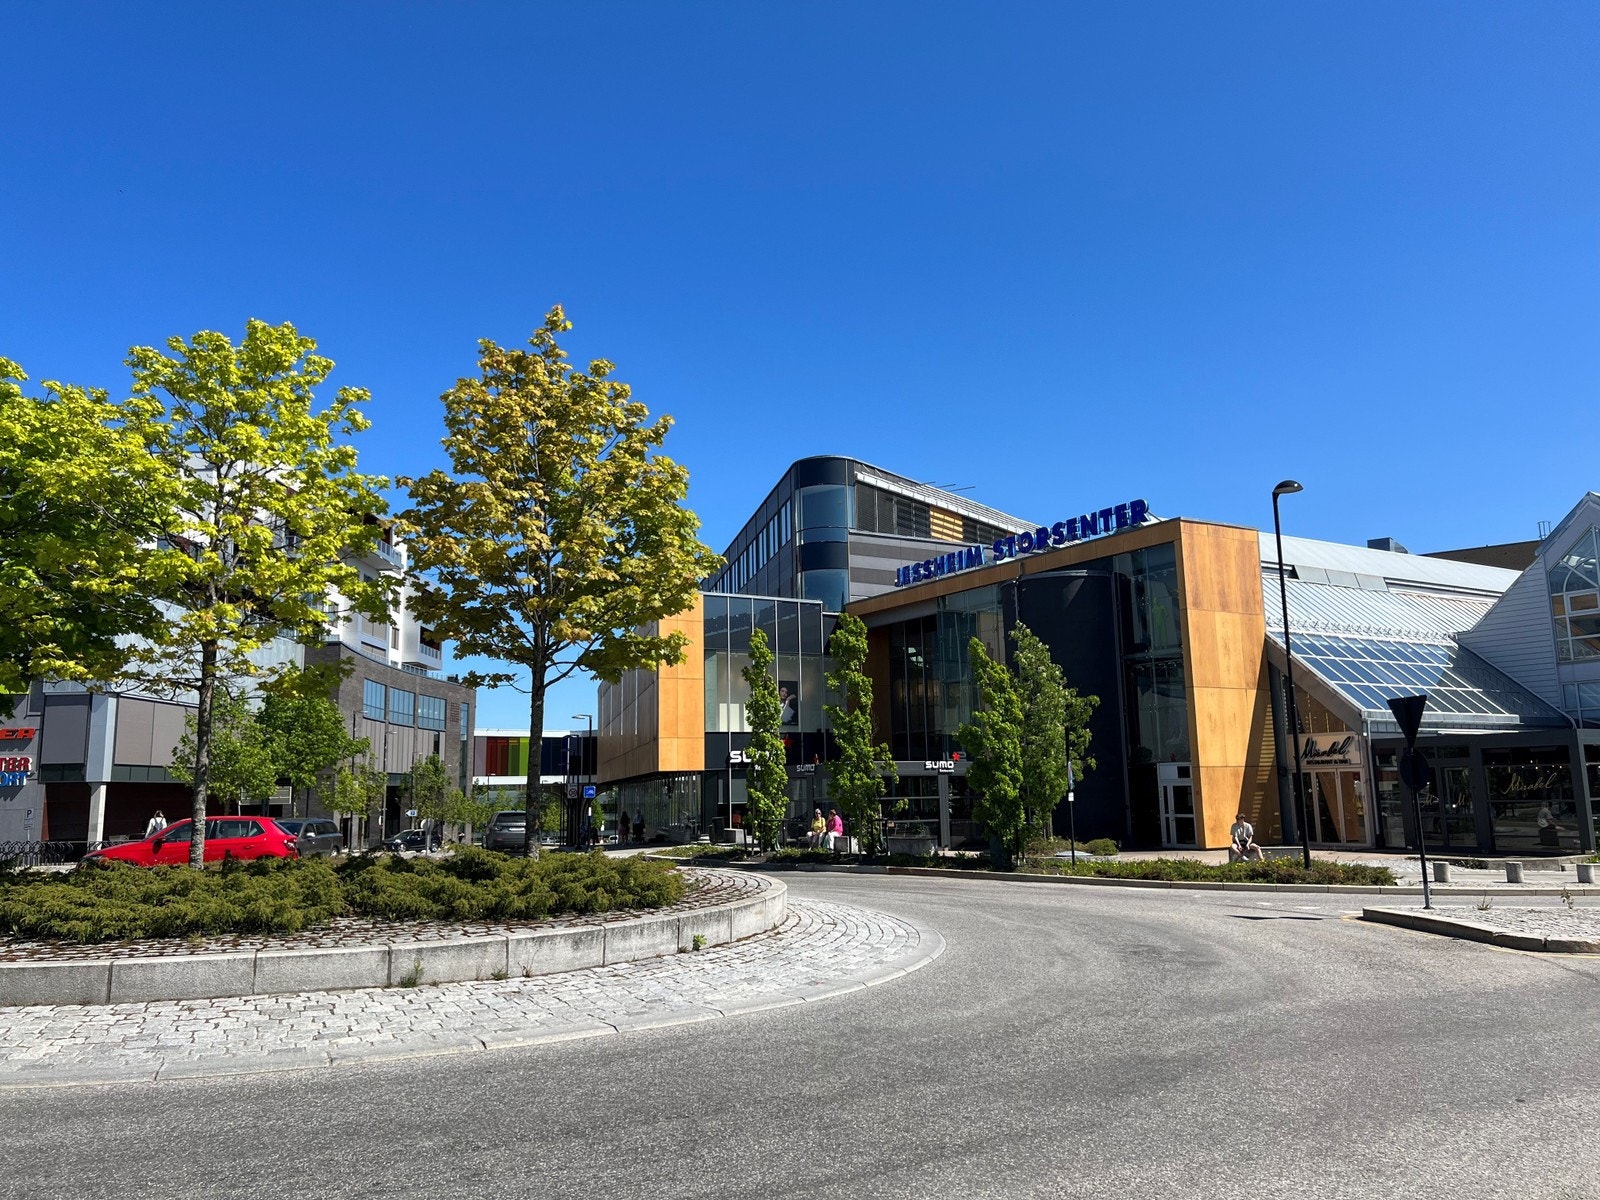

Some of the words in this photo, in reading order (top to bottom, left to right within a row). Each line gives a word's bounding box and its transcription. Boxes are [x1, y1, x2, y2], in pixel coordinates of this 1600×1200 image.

[895, 543, 986, 588] JESSHEIM
[993, 498, 1150, 562] STORSENTER
[925, 761, 955, 769] SUMO
[1502, 772, 1558, 796] Mirabel
[26, 809, 33, 818] P
